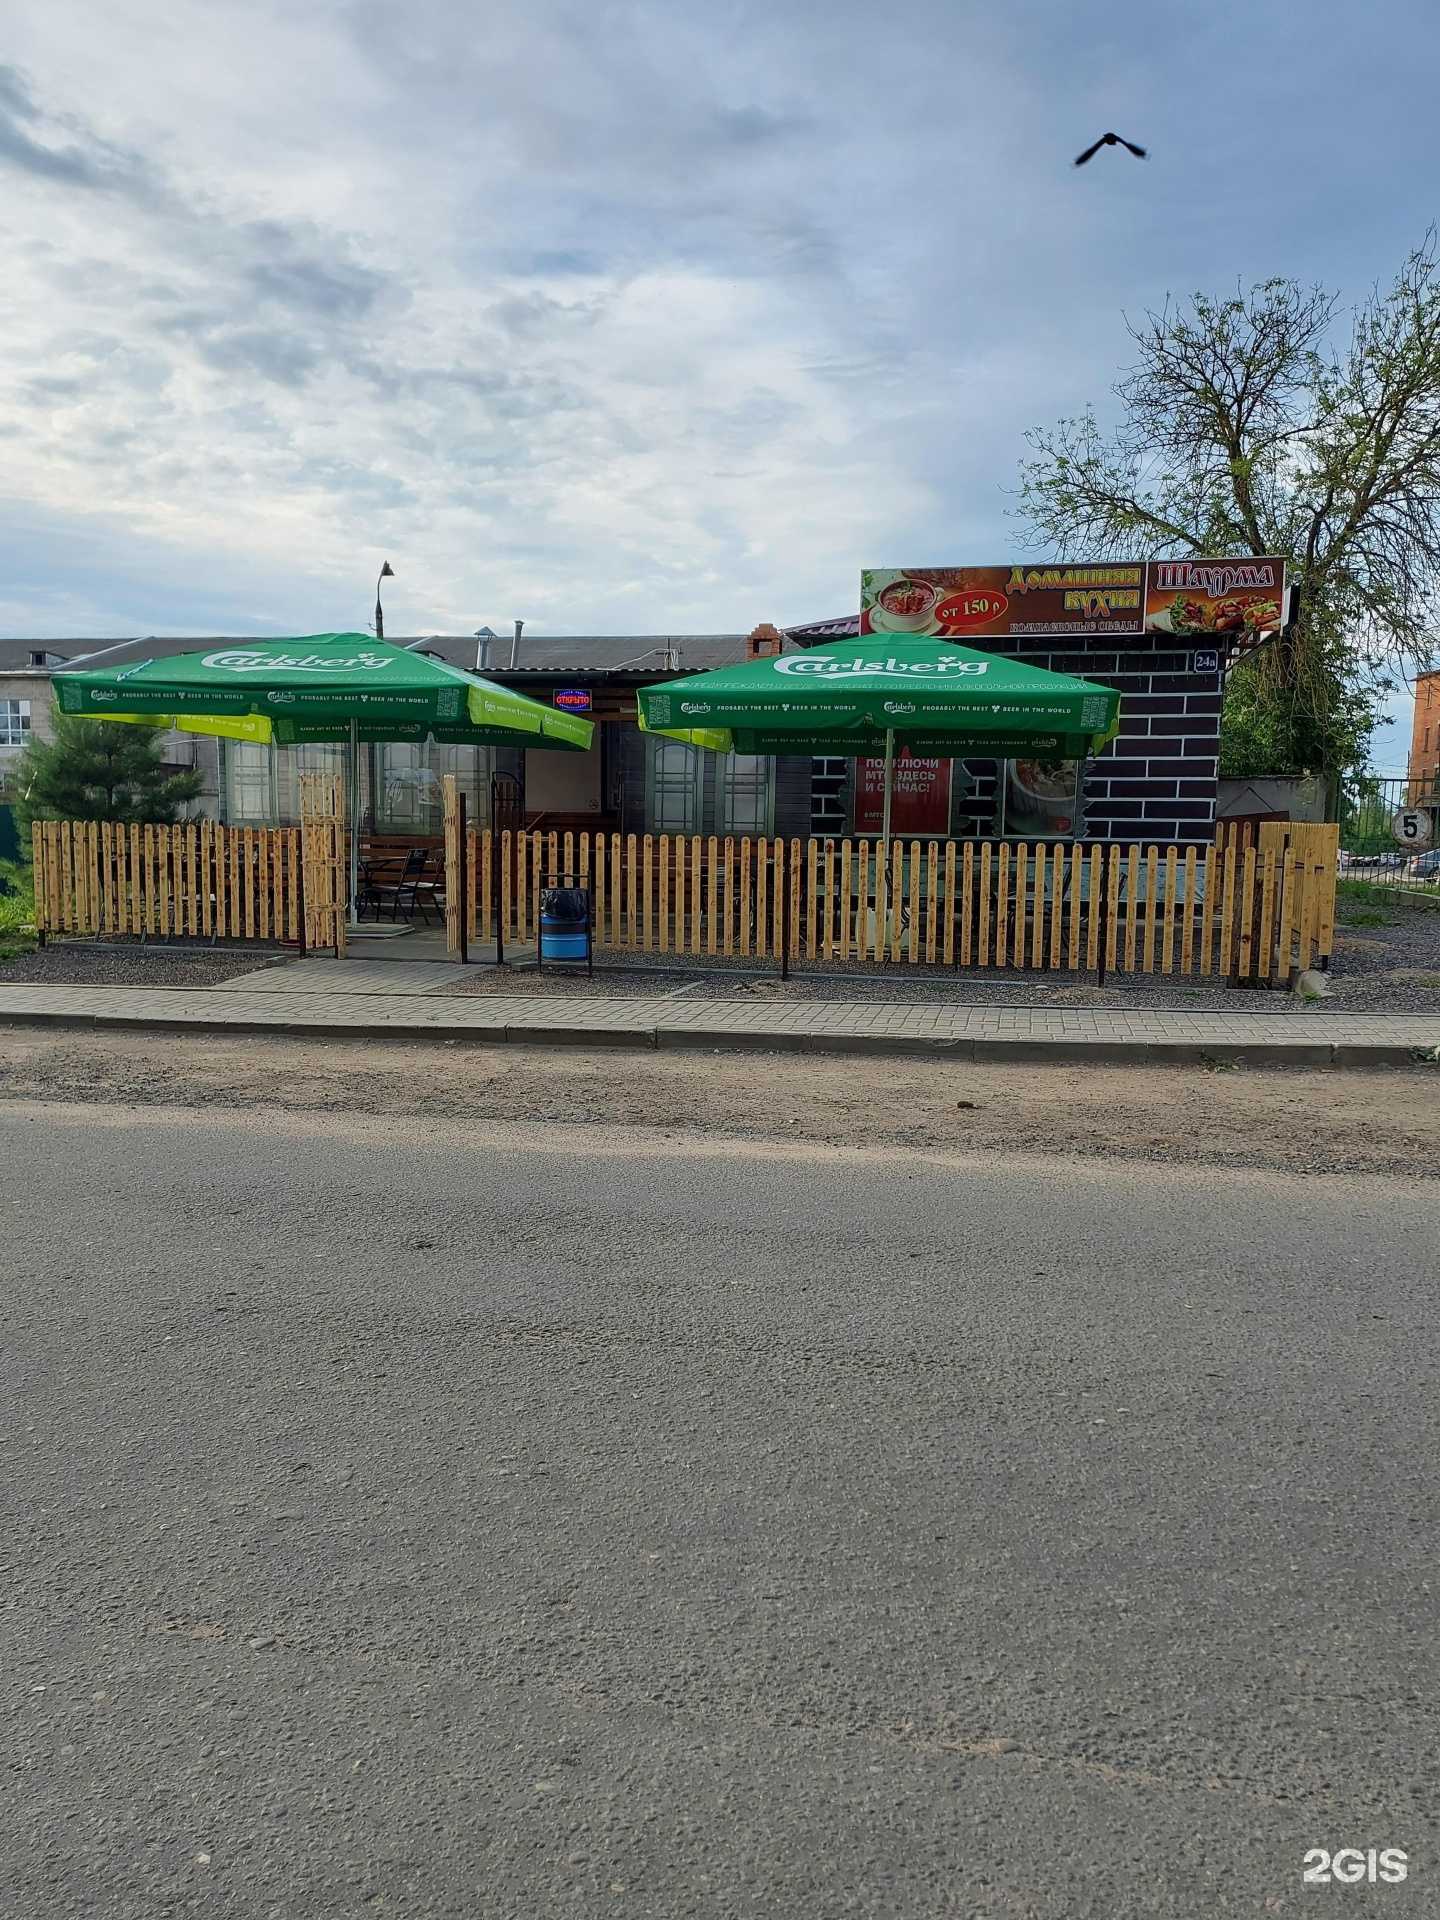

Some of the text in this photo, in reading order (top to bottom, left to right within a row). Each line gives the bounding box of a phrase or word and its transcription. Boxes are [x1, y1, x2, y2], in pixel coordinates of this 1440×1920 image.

[1006, 566, 1141, 595] Домашняя
[1157, 563, 1274, 597] Шаурма
[942, 607, 958, 619] от
[963, 600, 988, 616] 150
[201, 650, 397, 673] Carlsberg
[773, 656, 990, 679] Carlsberg
[267, 691, 296, 703] Carlsberg
[680, 702, 711, 714] Carlsberg
[883, 701, 916, 714] Carlsberg
[896, 771, 936, 781] ЗДЕСЬ
[866, 783, 873, 792] И
[1403, 815, 1418, 838] 5
